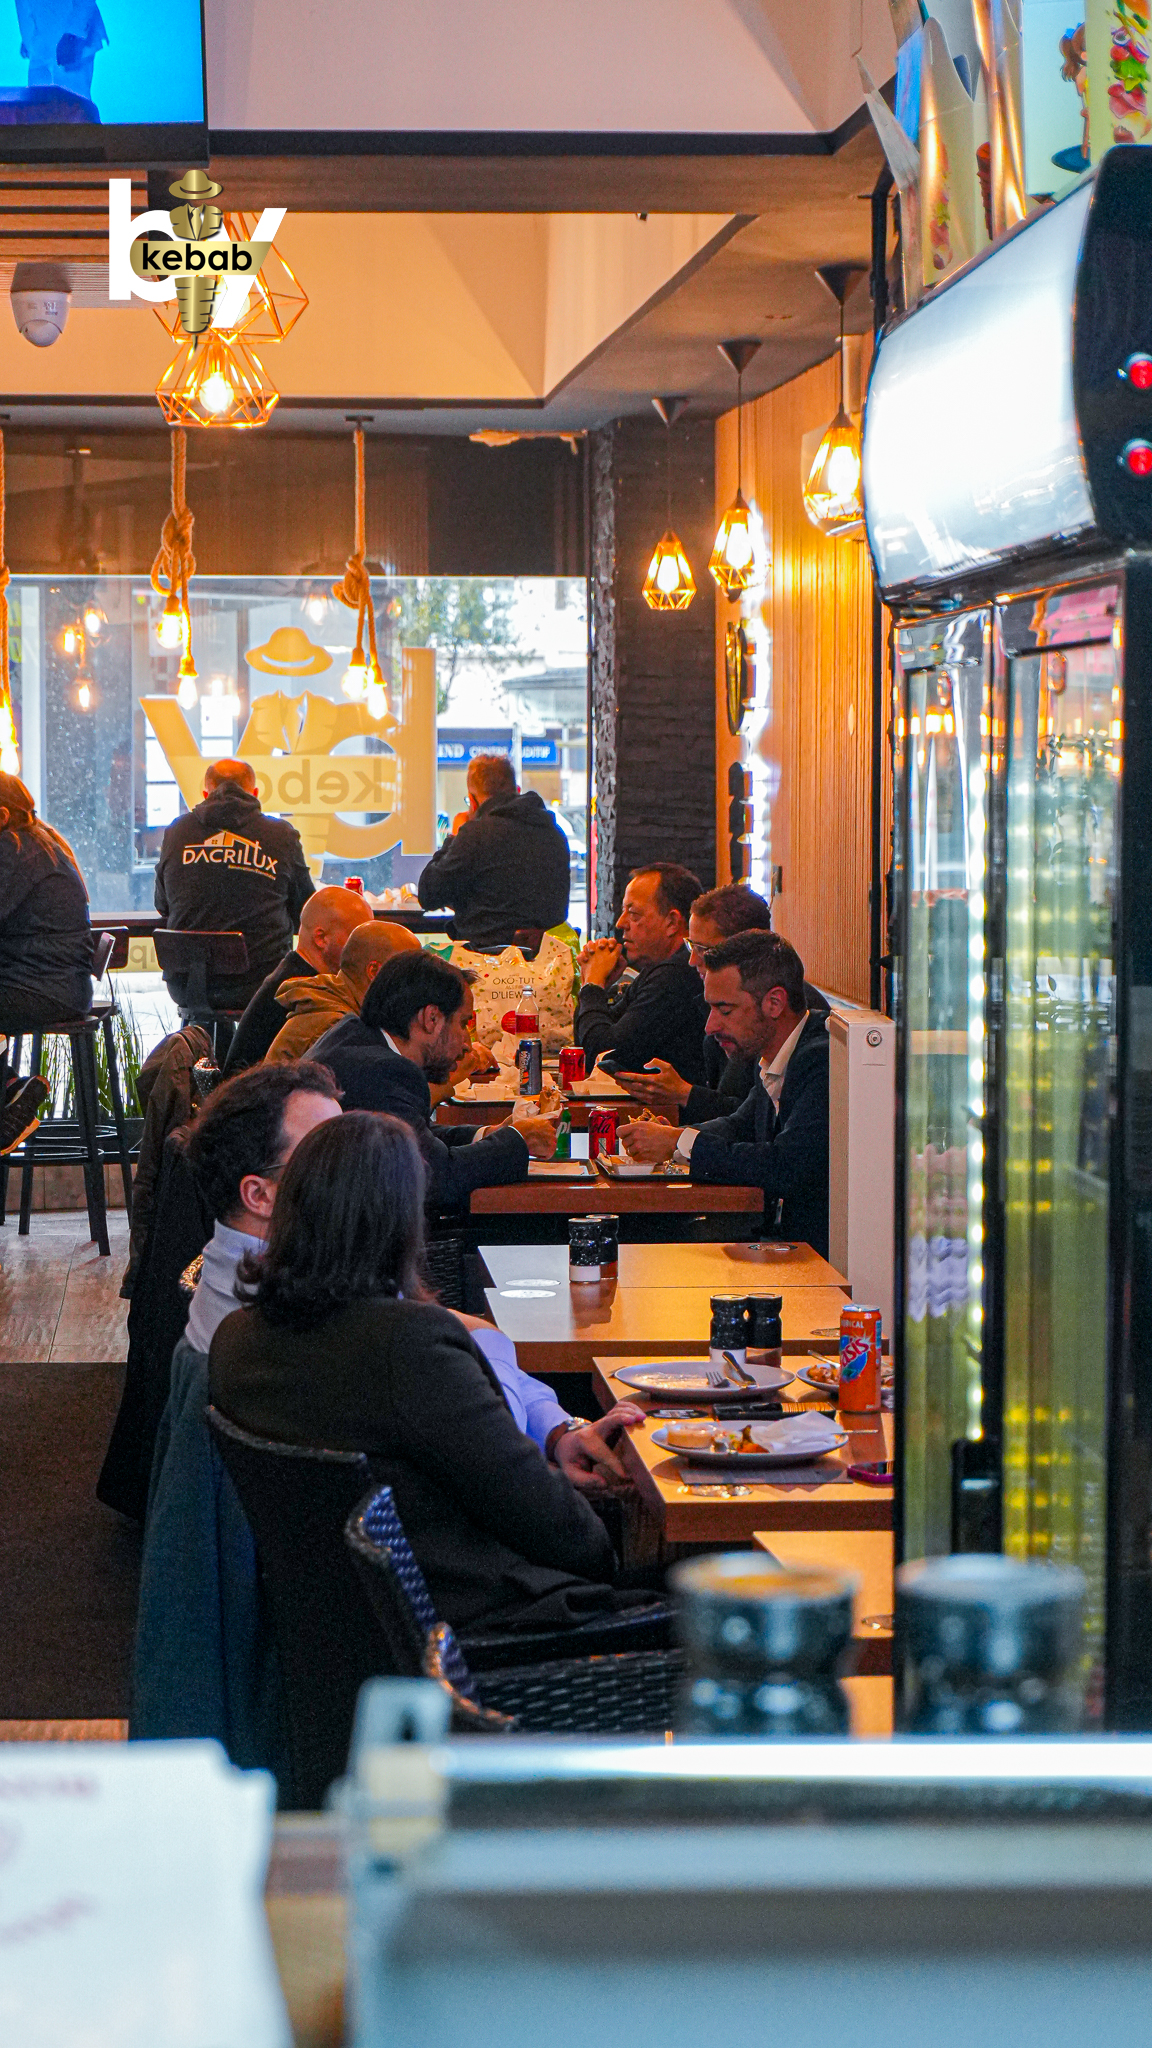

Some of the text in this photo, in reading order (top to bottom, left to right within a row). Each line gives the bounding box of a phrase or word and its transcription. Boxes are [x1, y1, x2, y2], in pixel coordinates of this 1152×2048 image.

[437, 743, 465, 759] IND
[182, 840, 278, 875] DACRILUX
[491, 990, 537, 1000] D'LIEWN
[841, 1338, 870, 1368] asis
